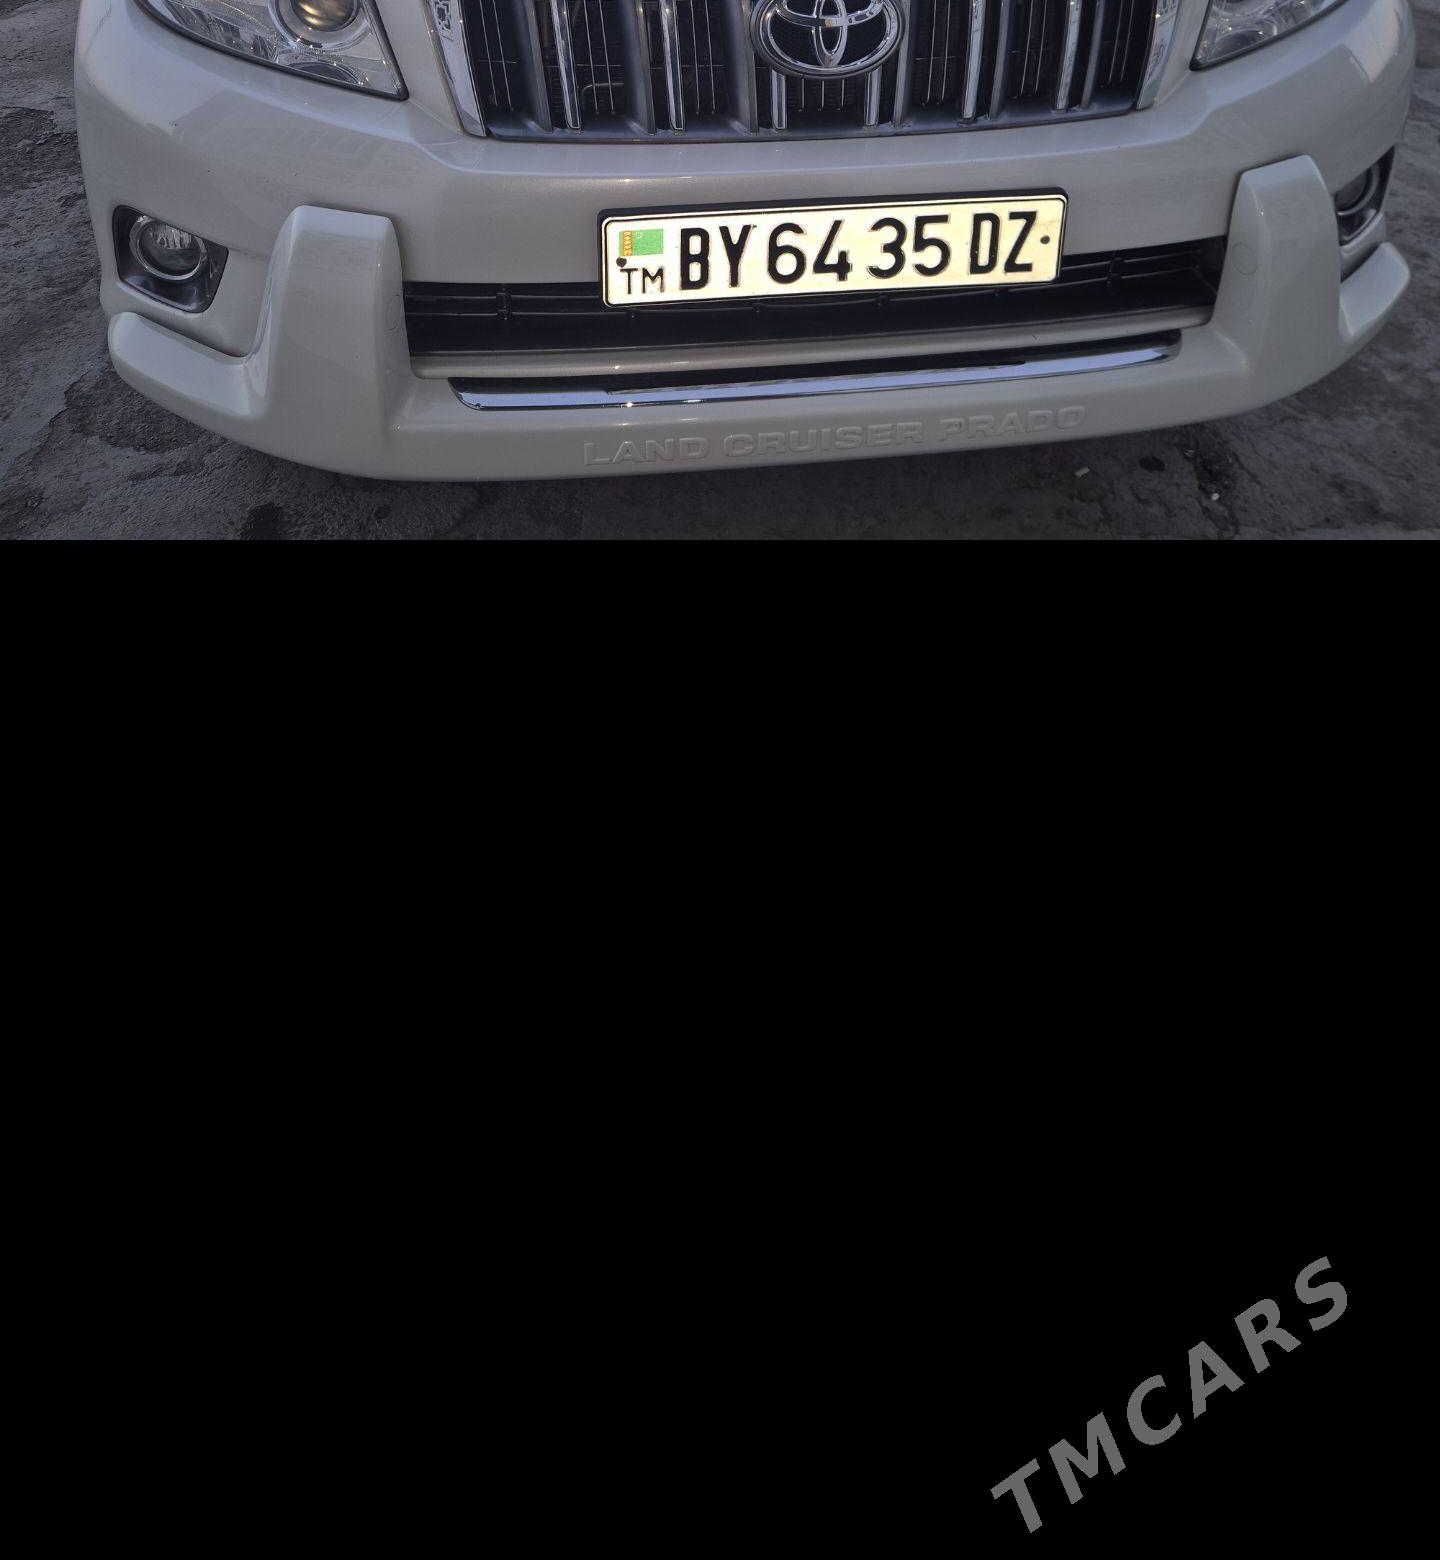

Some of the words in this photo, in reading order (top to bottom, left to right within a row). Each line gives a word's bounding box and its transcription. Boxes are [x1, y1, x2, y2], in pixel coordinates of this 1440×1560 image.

[620, 267, 665, 296] TM
[679, 224, 752, 291] BY
[766, 219, 852, 282] 64
[866, 214, 951, 278] 35
[969, 211, 1038, 275] DZ
[583, 436, 709, 466] LAND
[722, 420, 925, 457] CRUISER
[939, 405, 1087, 439] PRADO
